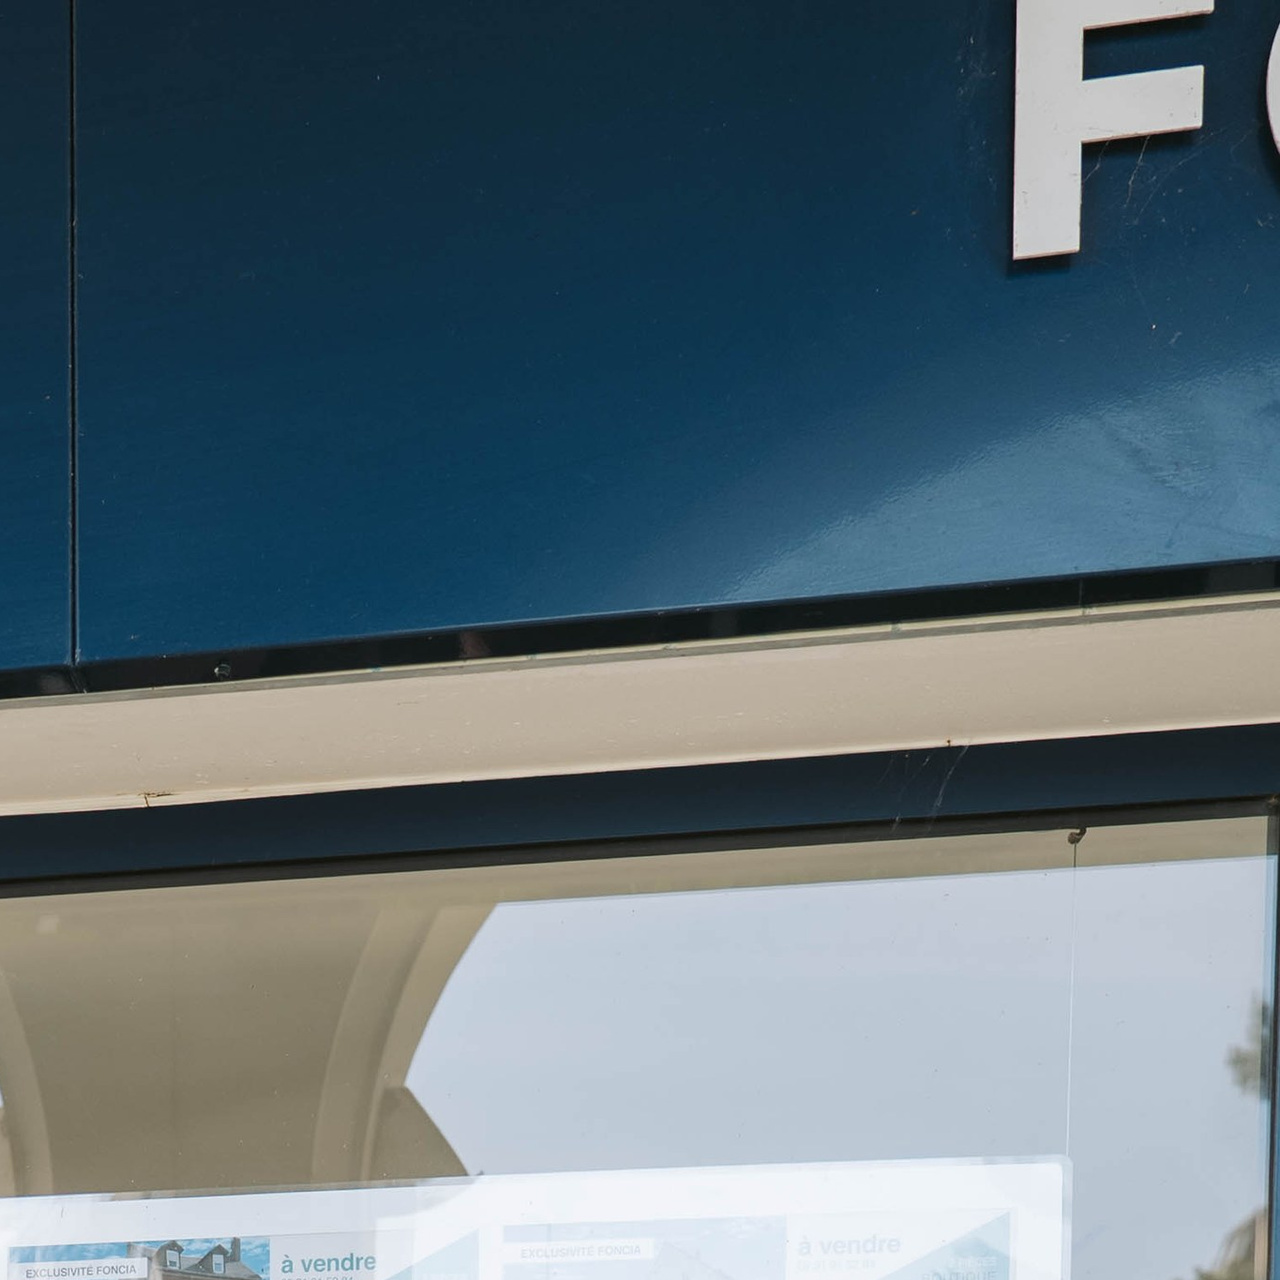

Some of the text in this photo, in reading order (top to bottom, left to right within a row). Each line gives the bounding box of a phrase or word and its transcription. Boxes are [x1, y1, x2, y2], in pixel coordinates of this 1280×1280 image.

[1013, 0, 1280, 260] F
[799, 1235, 901, 1256] à vendre
[96, 1264, 136, 1275] FONCIA
[281, 1253, 376, 1273] à vendre
